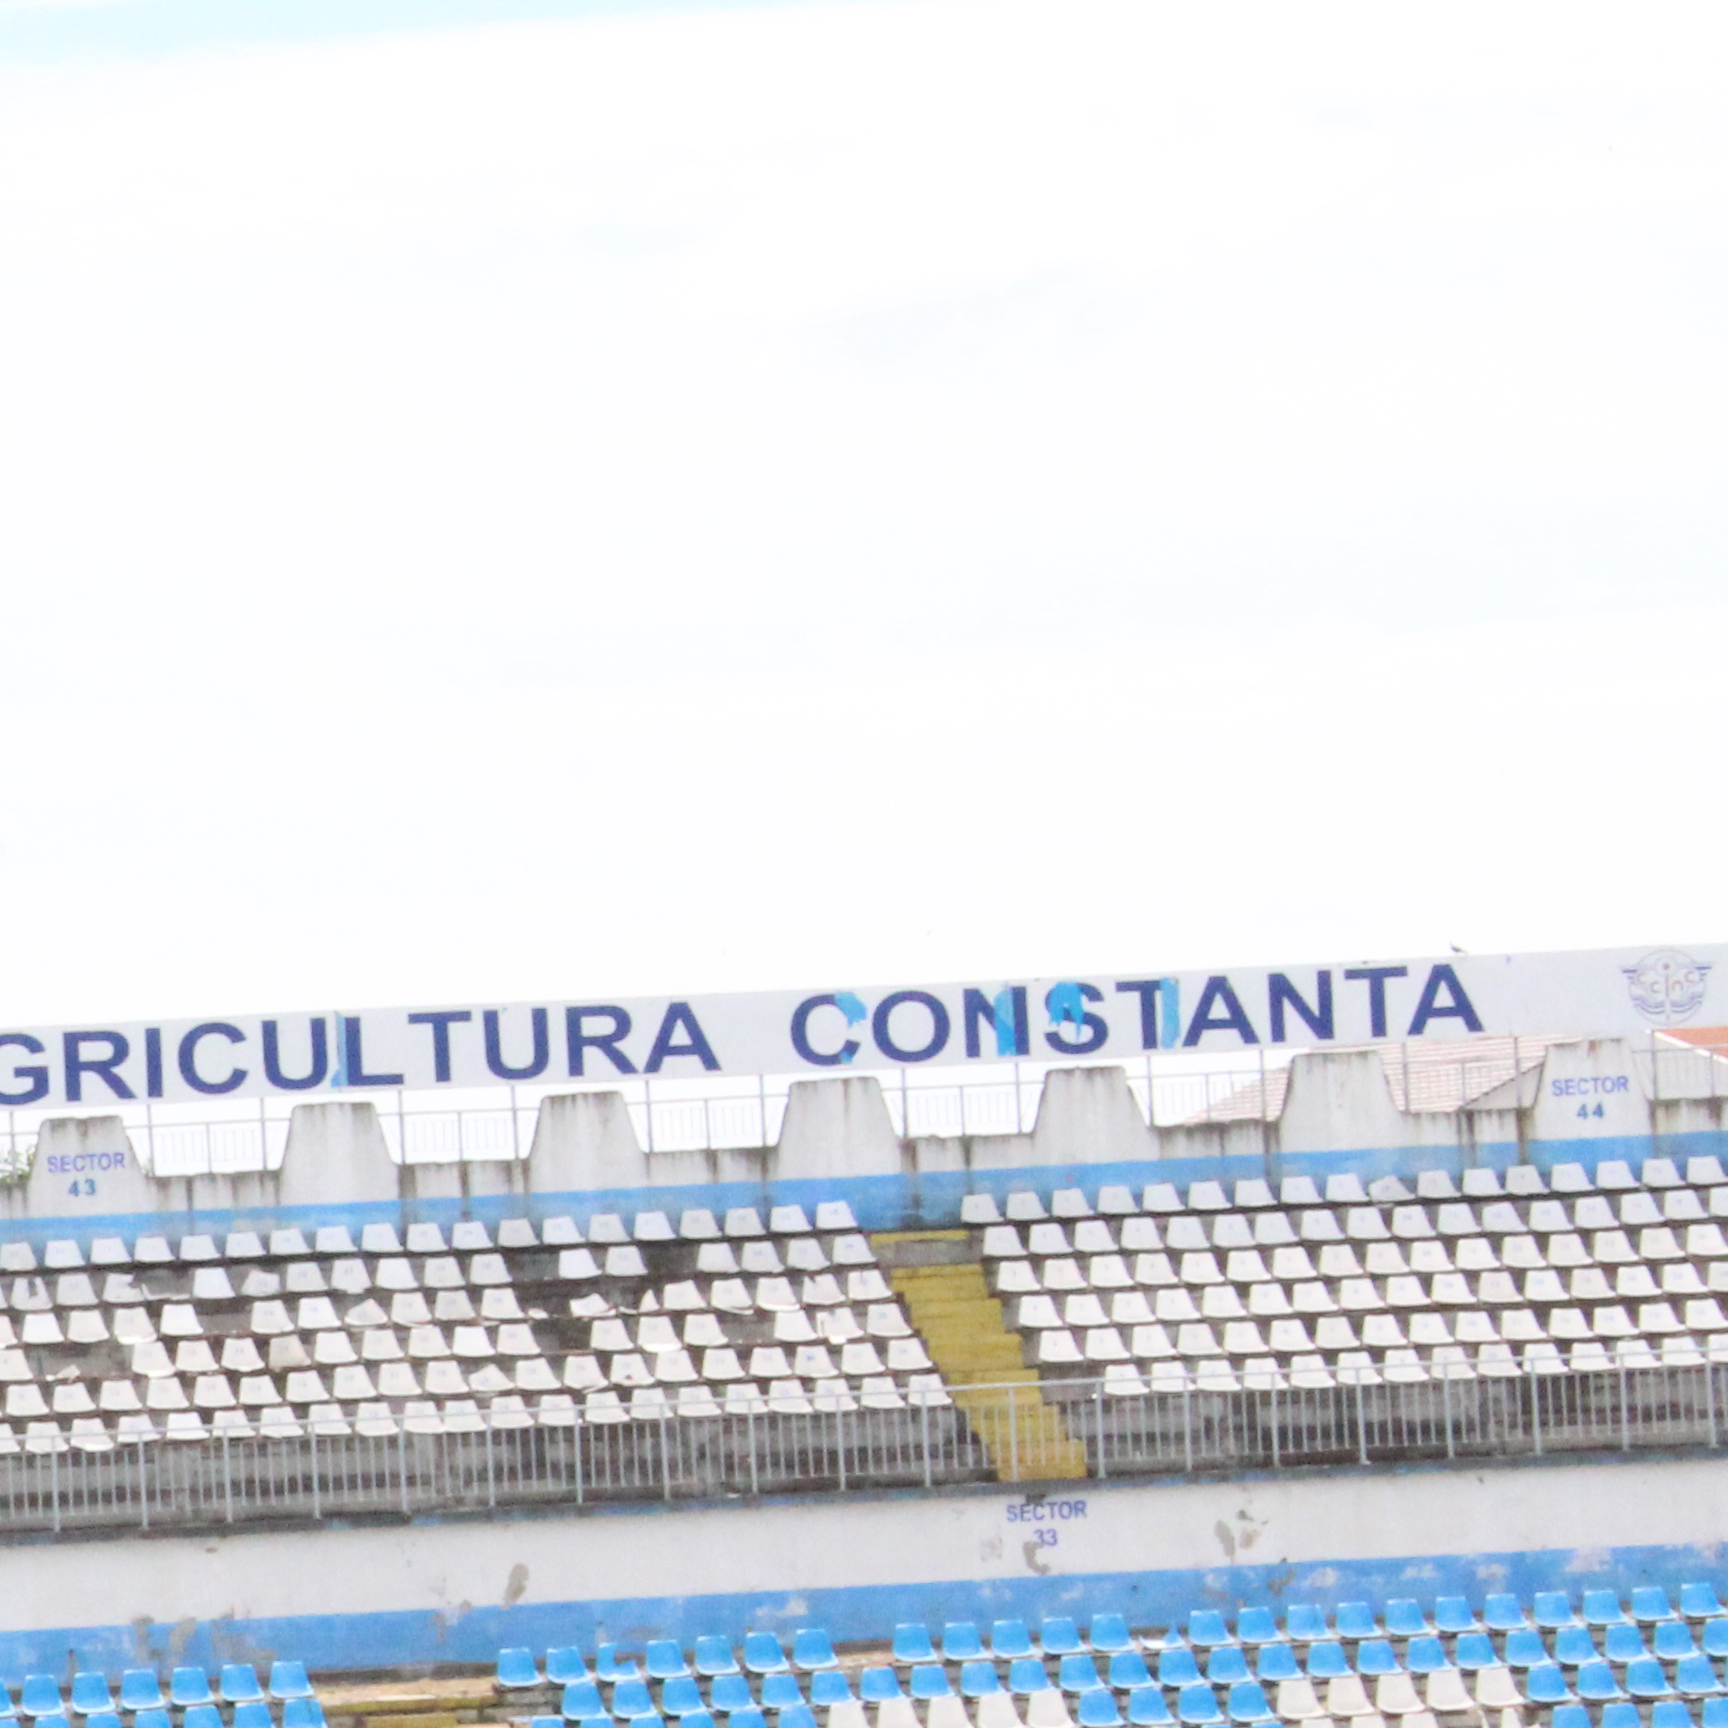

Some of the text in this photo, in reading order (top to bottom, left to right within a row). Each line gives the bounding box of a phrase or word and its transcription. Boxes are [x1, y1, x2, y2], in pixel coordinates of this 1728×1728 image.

[790, 963, 1482, 1066] CONSTANTA
[1551, 1075, 1630, 1097] SECTOR
[1577, 1102, 1604, 1119] 44
[47, 1152, 126, 1174] SECTOR
[68, 1178, 97, 1197] 43
[1006, 1500, 1088, 1523] SECTOR
[1033, 1528, 1058, 1547] 33
